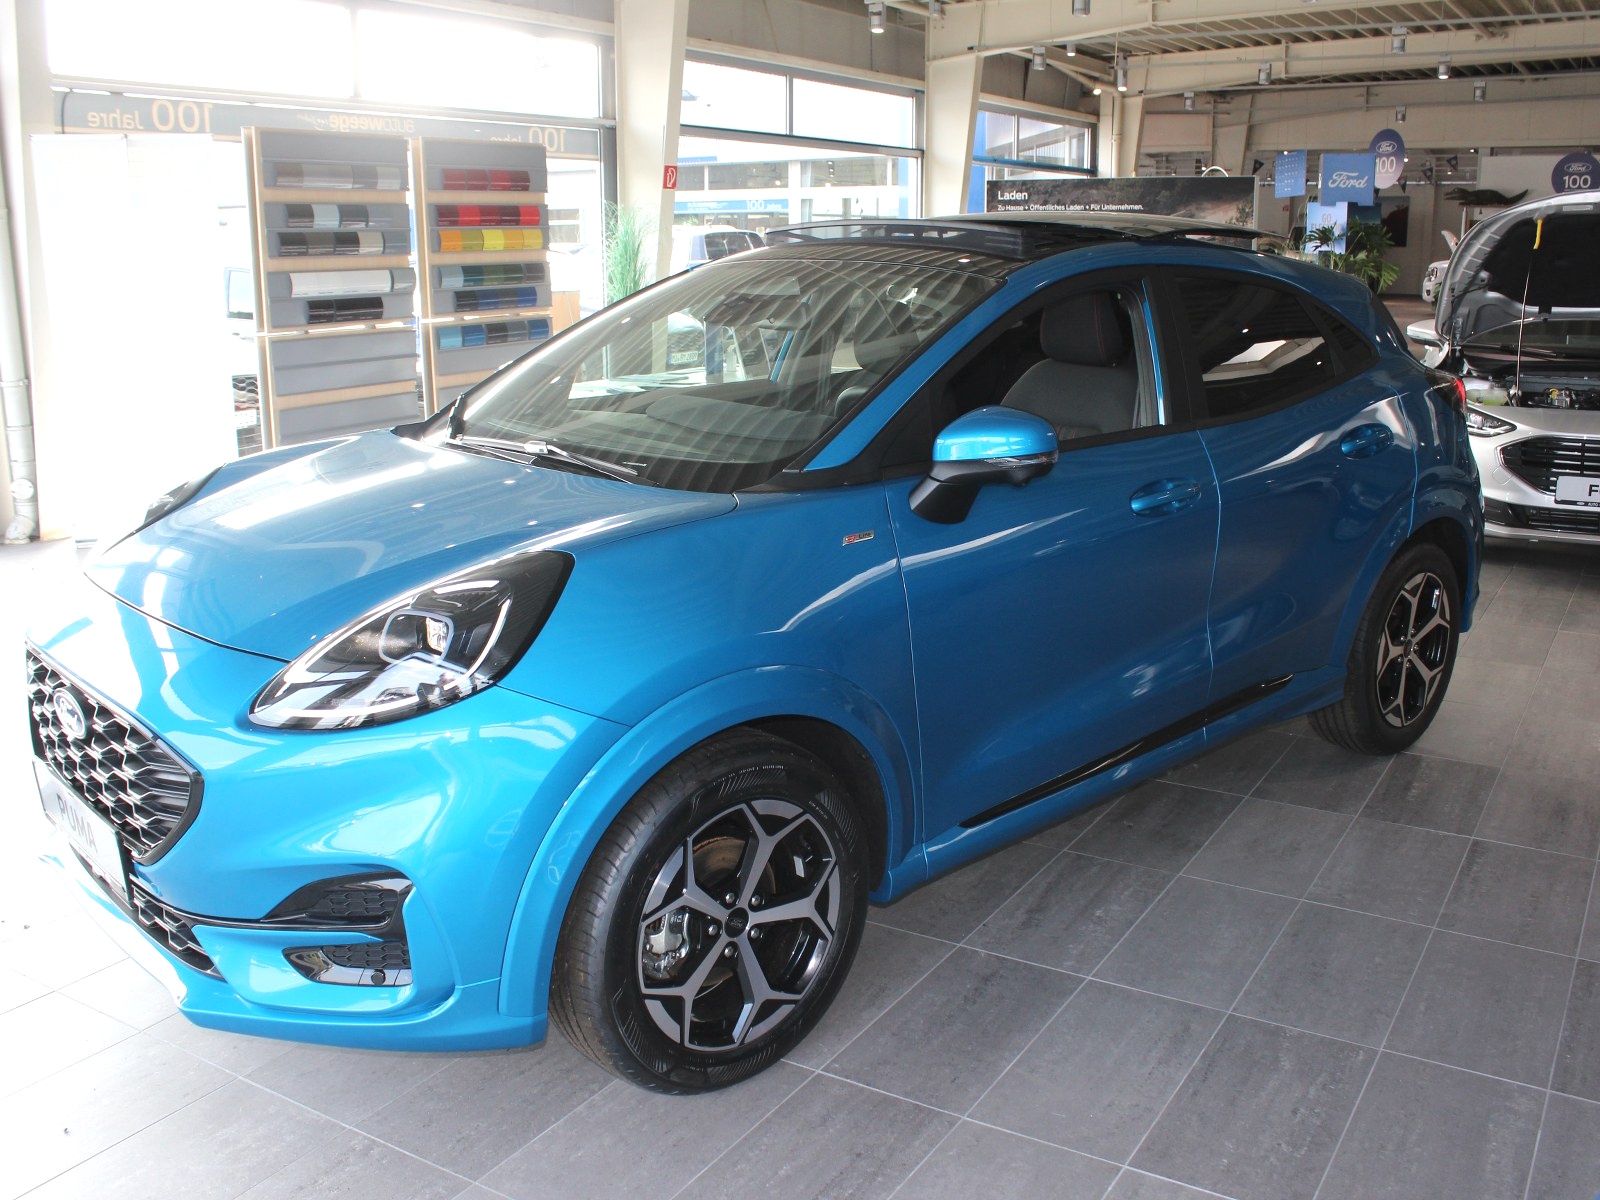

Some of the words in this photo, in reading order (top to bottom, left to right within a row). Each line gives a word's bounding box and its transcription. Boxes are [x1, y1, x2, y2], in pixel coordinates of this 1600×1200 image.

[1376, 156, 1396, 173] 100
[1328, 171, 1368, 188] Ford
[1563, 175, 1591, 188] 100
[998, 190, 1028, 200] Laden
[56, 793, 98, 853] PUMA
